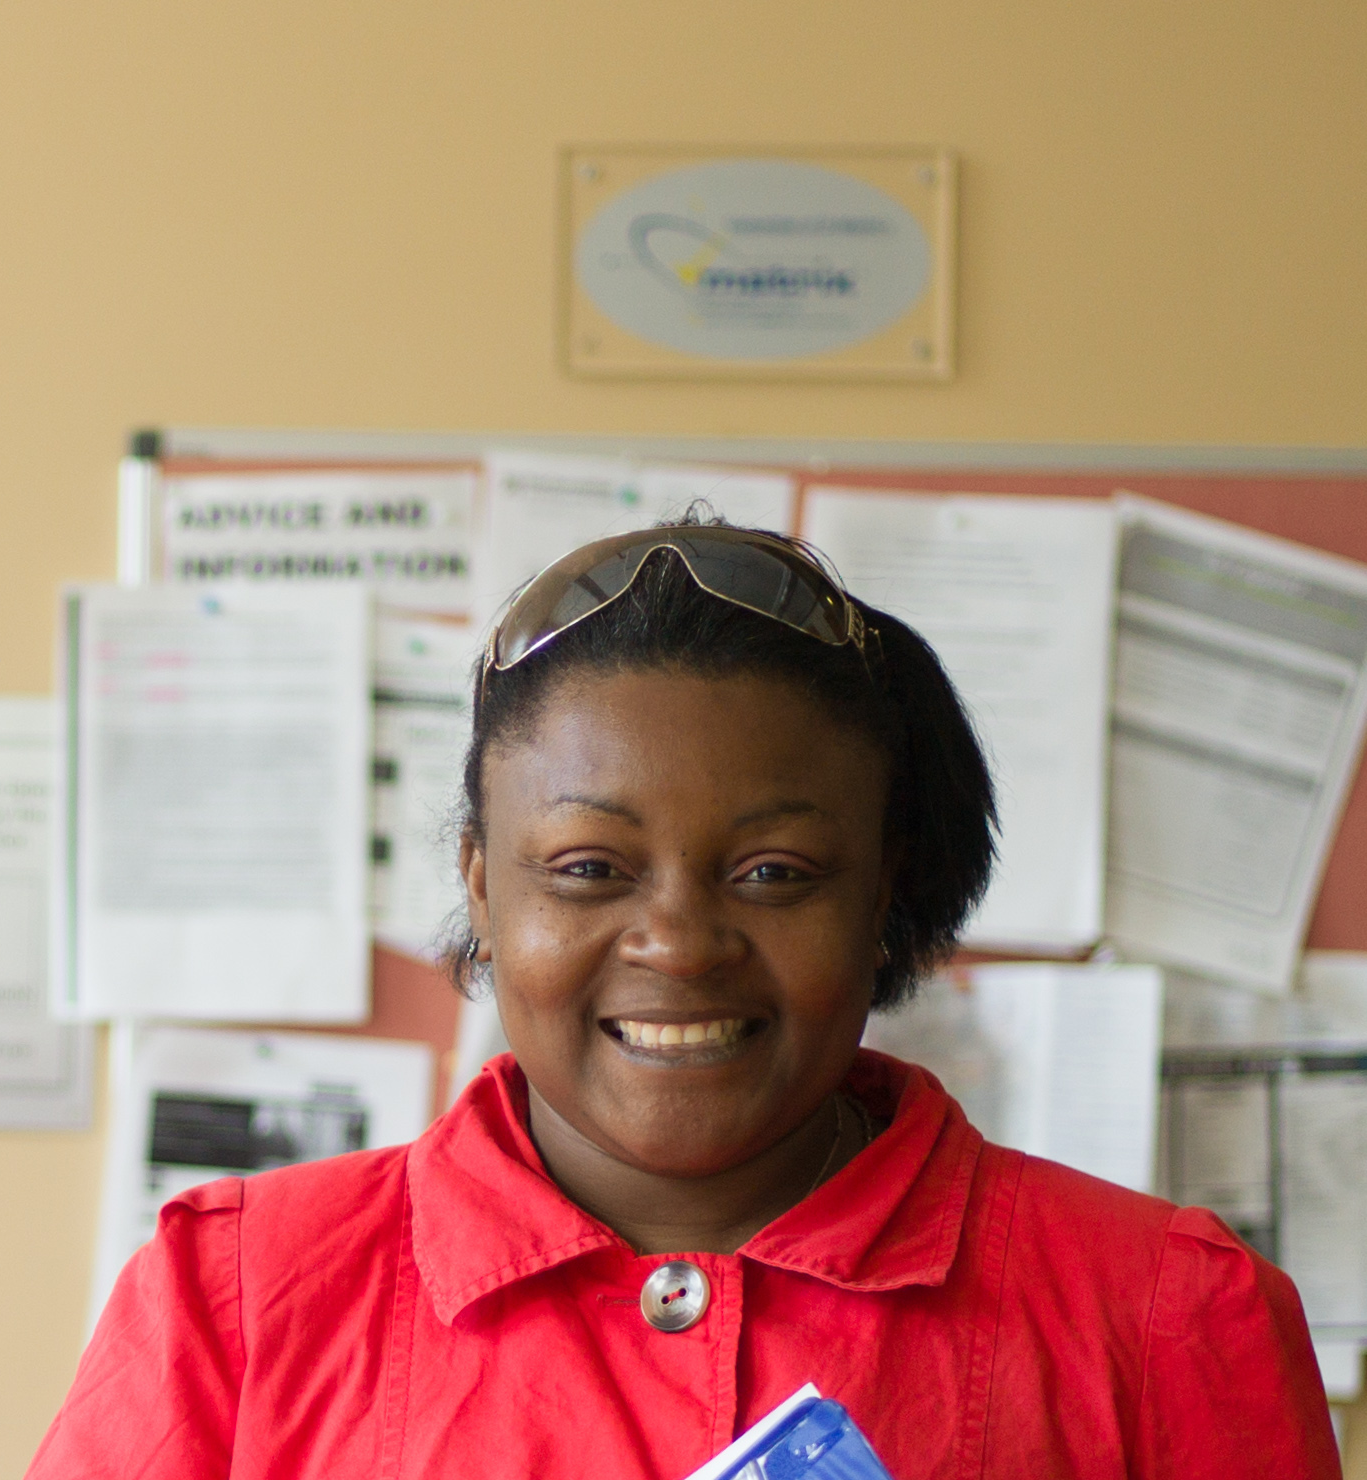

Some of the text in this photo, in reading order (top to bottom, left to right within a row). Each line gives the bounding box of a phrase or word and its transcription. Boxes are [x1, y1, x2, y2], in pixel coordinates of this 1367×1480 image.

[179, 498, 429, 529] ADVICE AND
[178, 550, 471, 580] INFORMATION
